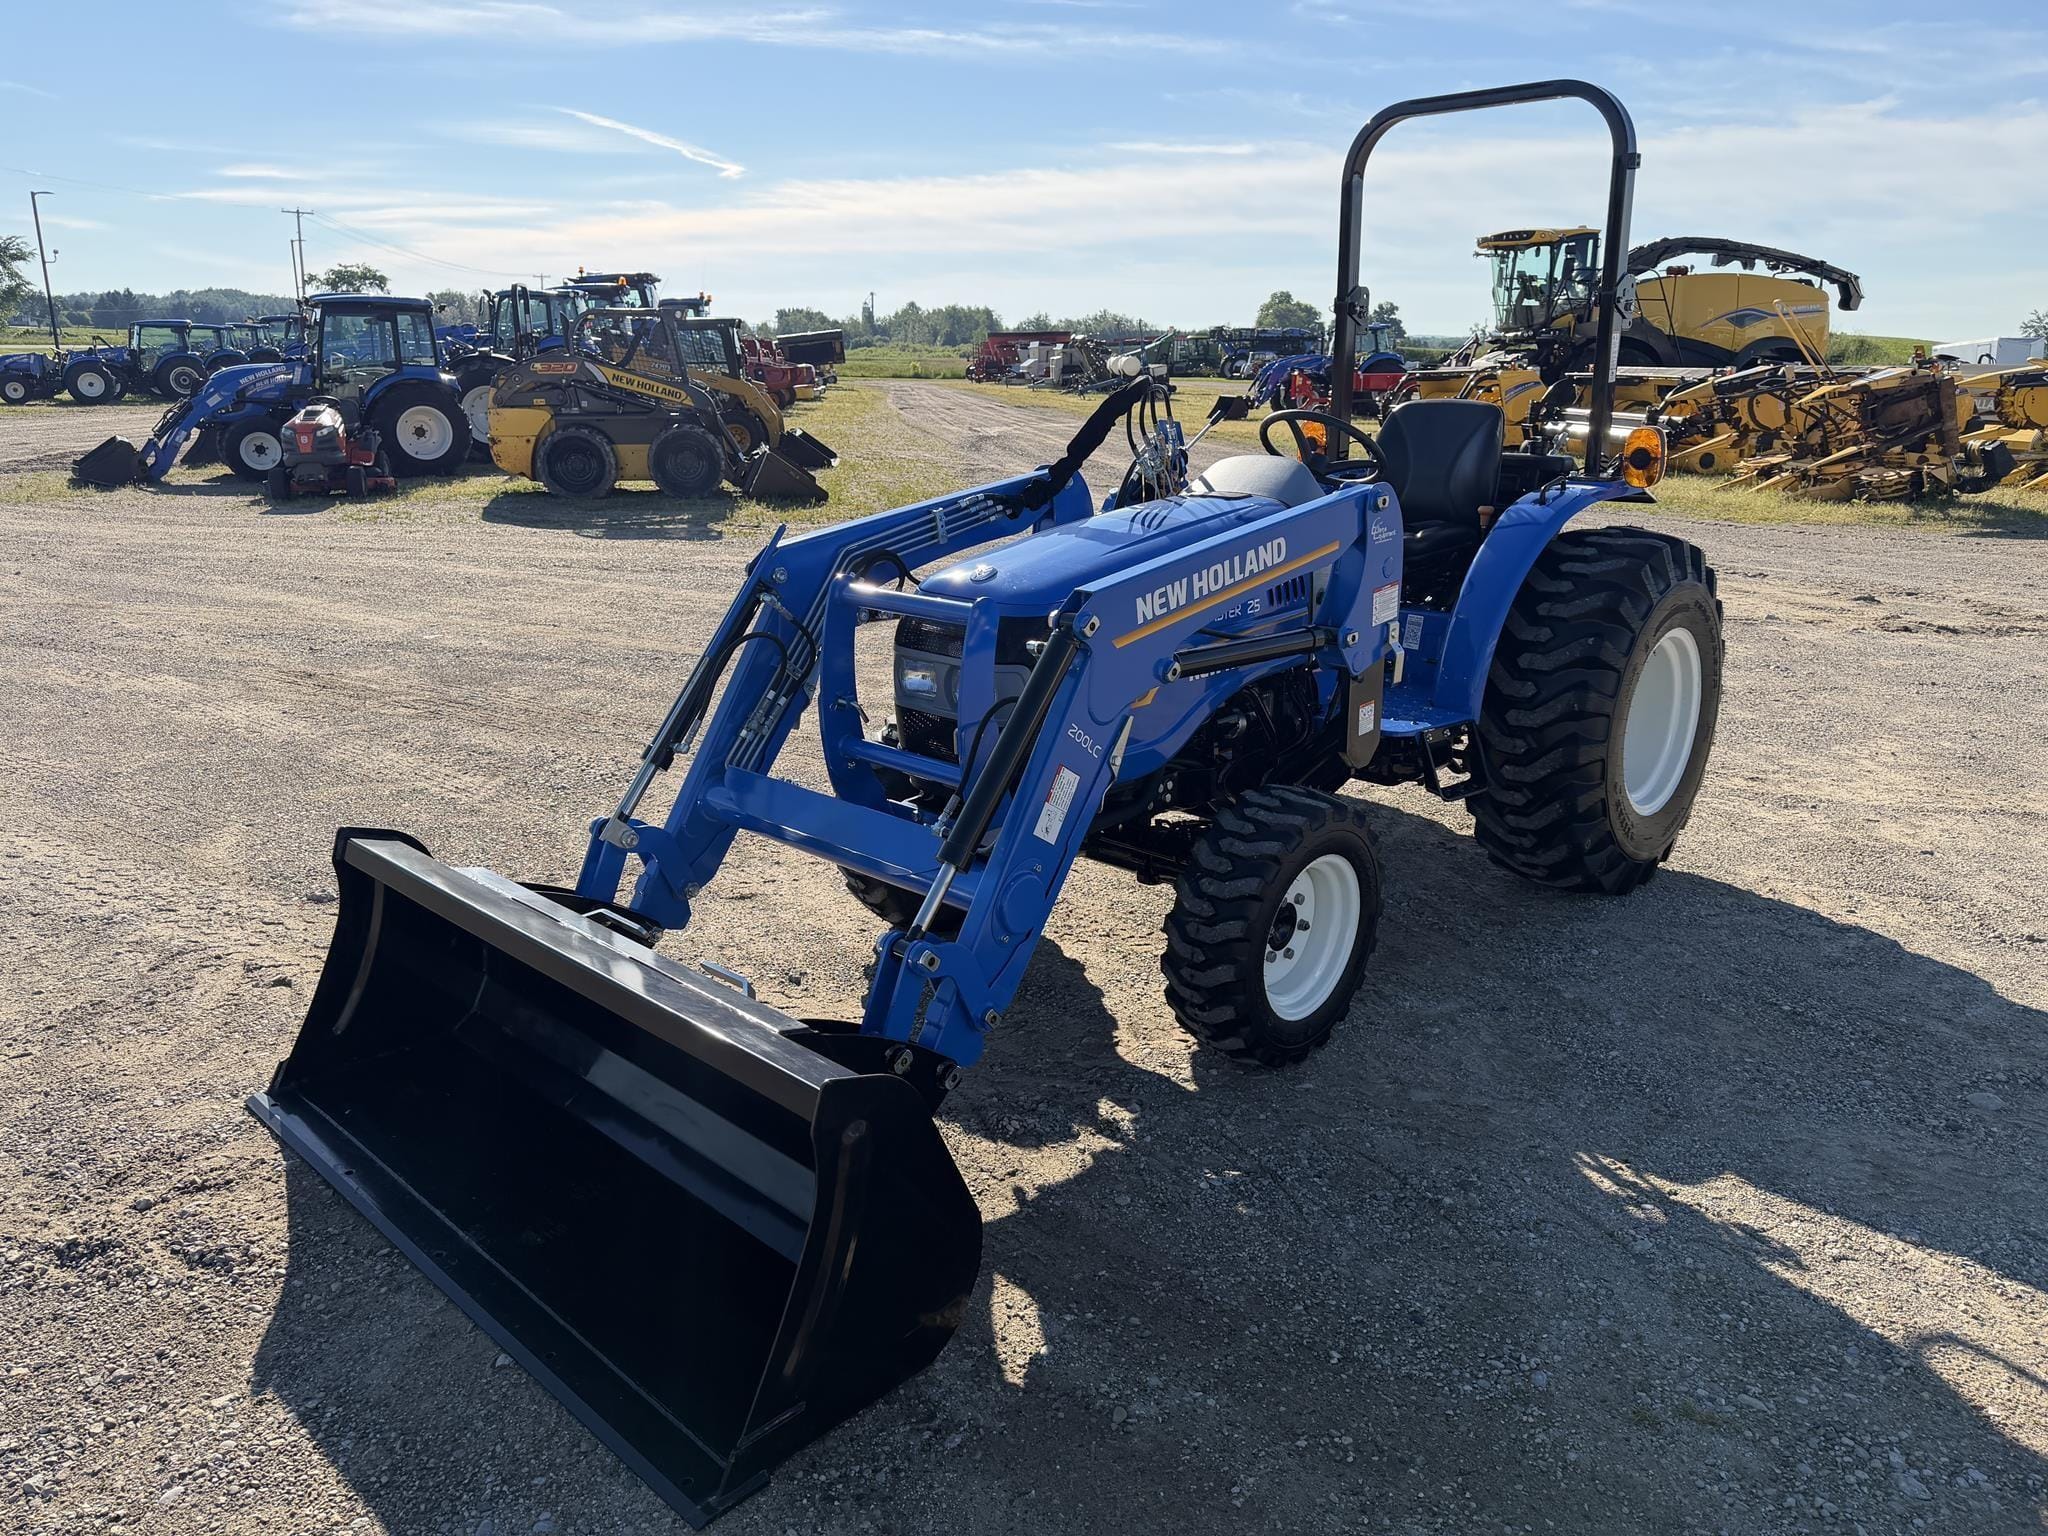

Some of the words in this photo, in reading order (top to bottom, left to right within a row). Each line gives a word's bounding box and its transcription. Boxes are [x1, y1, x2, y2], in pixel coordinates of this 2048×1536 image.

[255, 366, 287, 379] HOLLAND
[530, 363, 577, 374] L320
[612, 373, 635, 386] NEW
[636, 378, 682, 400] HOLLAND
[1136, 577, 1188, 625] NEW
[1193, 536, 1287, 600] HOLLAND
[1247, 598, 1261, 614] 25
[1067, 723, 1103, 758] 200LC
